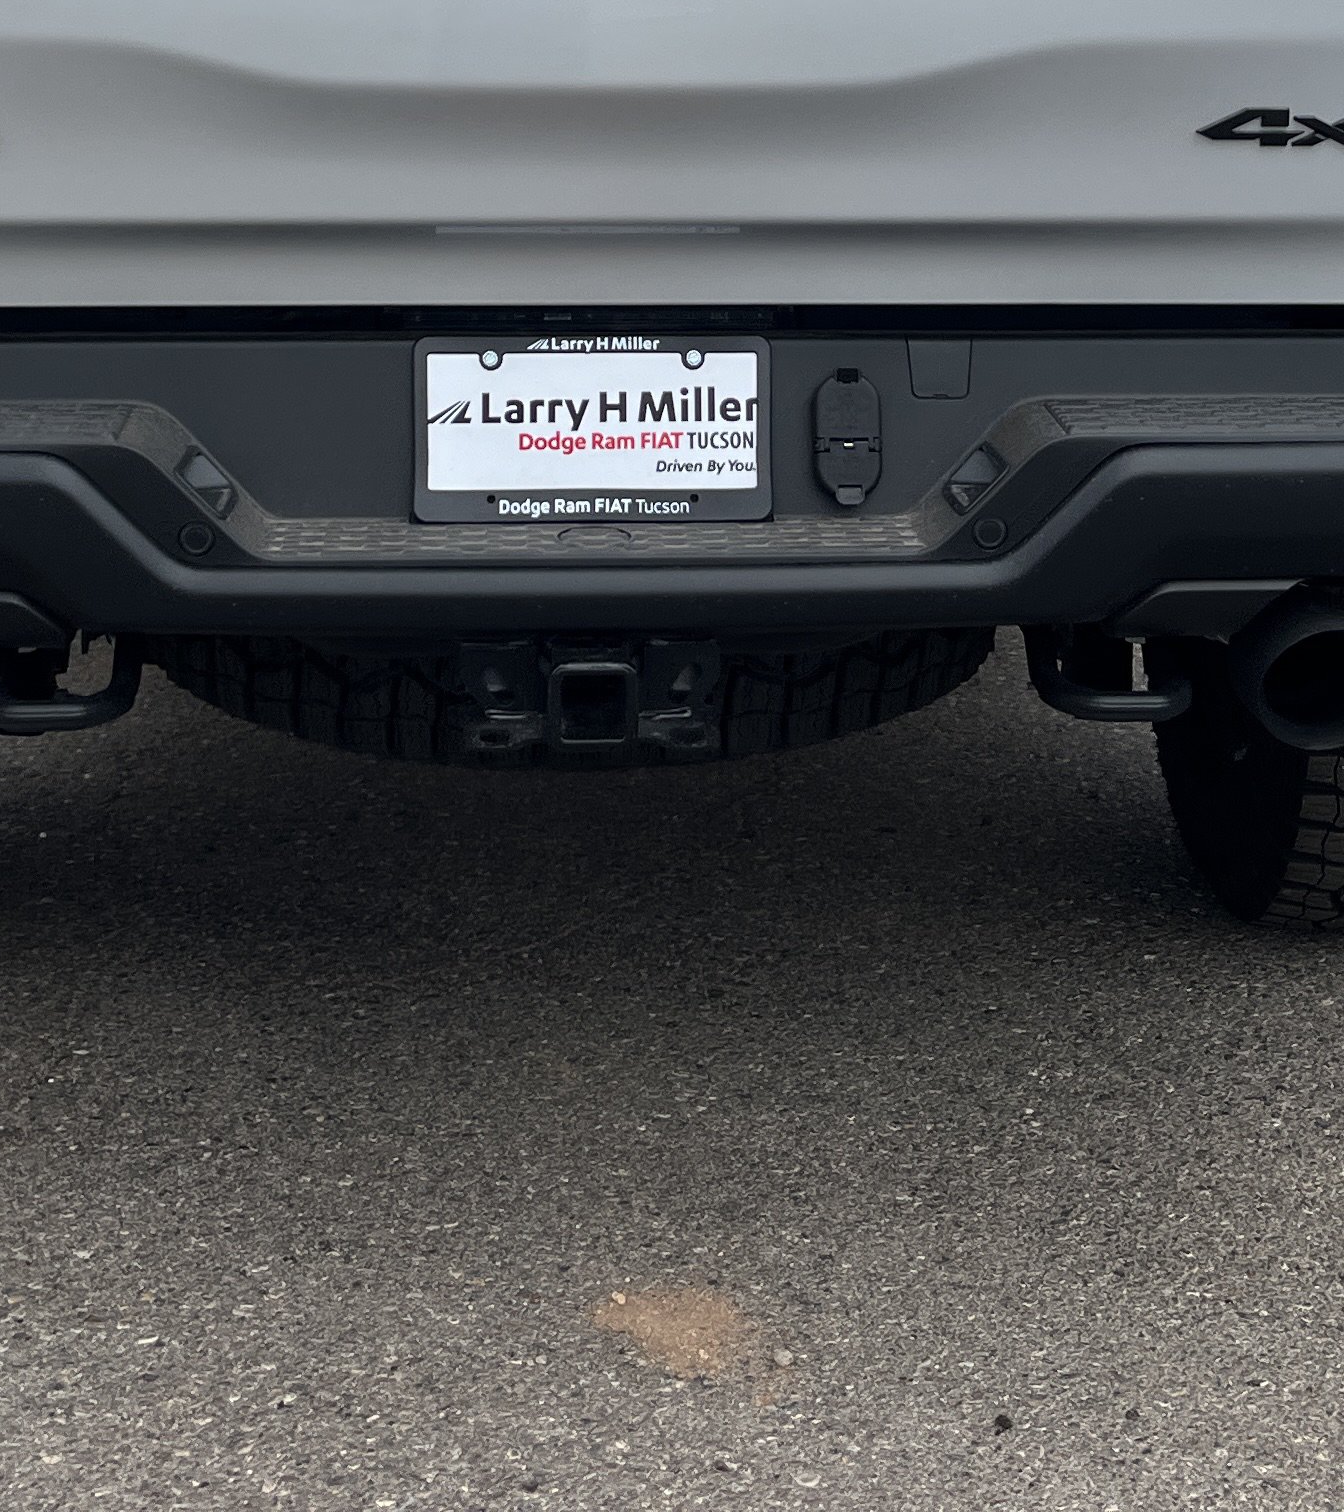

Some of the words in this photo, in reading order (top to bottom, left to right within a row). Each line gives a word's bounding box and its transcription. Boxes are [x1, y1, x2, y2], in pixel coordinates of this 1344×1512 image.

[551, 337, 594, 353] Larry
[597, 336, 609, 350] H
[611, 336, 660, 350] Miller
[481, 392, 590, 431] Larry
[599, 391, 627, 423] H
[637, 386, 757, 423] Miller
[518, 431, 586, 455] Dodge
[591, 432, 635, 450] Ram
[640, 431, 684, 449] FIAT
[687, 431, 754, 449] TUCSON
[656, 459, 703, 473] Driven
[707, 459, 726, 475] By
[498, 498, 550, 518] Dodge
[554, 499, 591, 514] Ram
[594, 498, 632, 514] FIAT
[635, 498, 690, 514] Tucson
